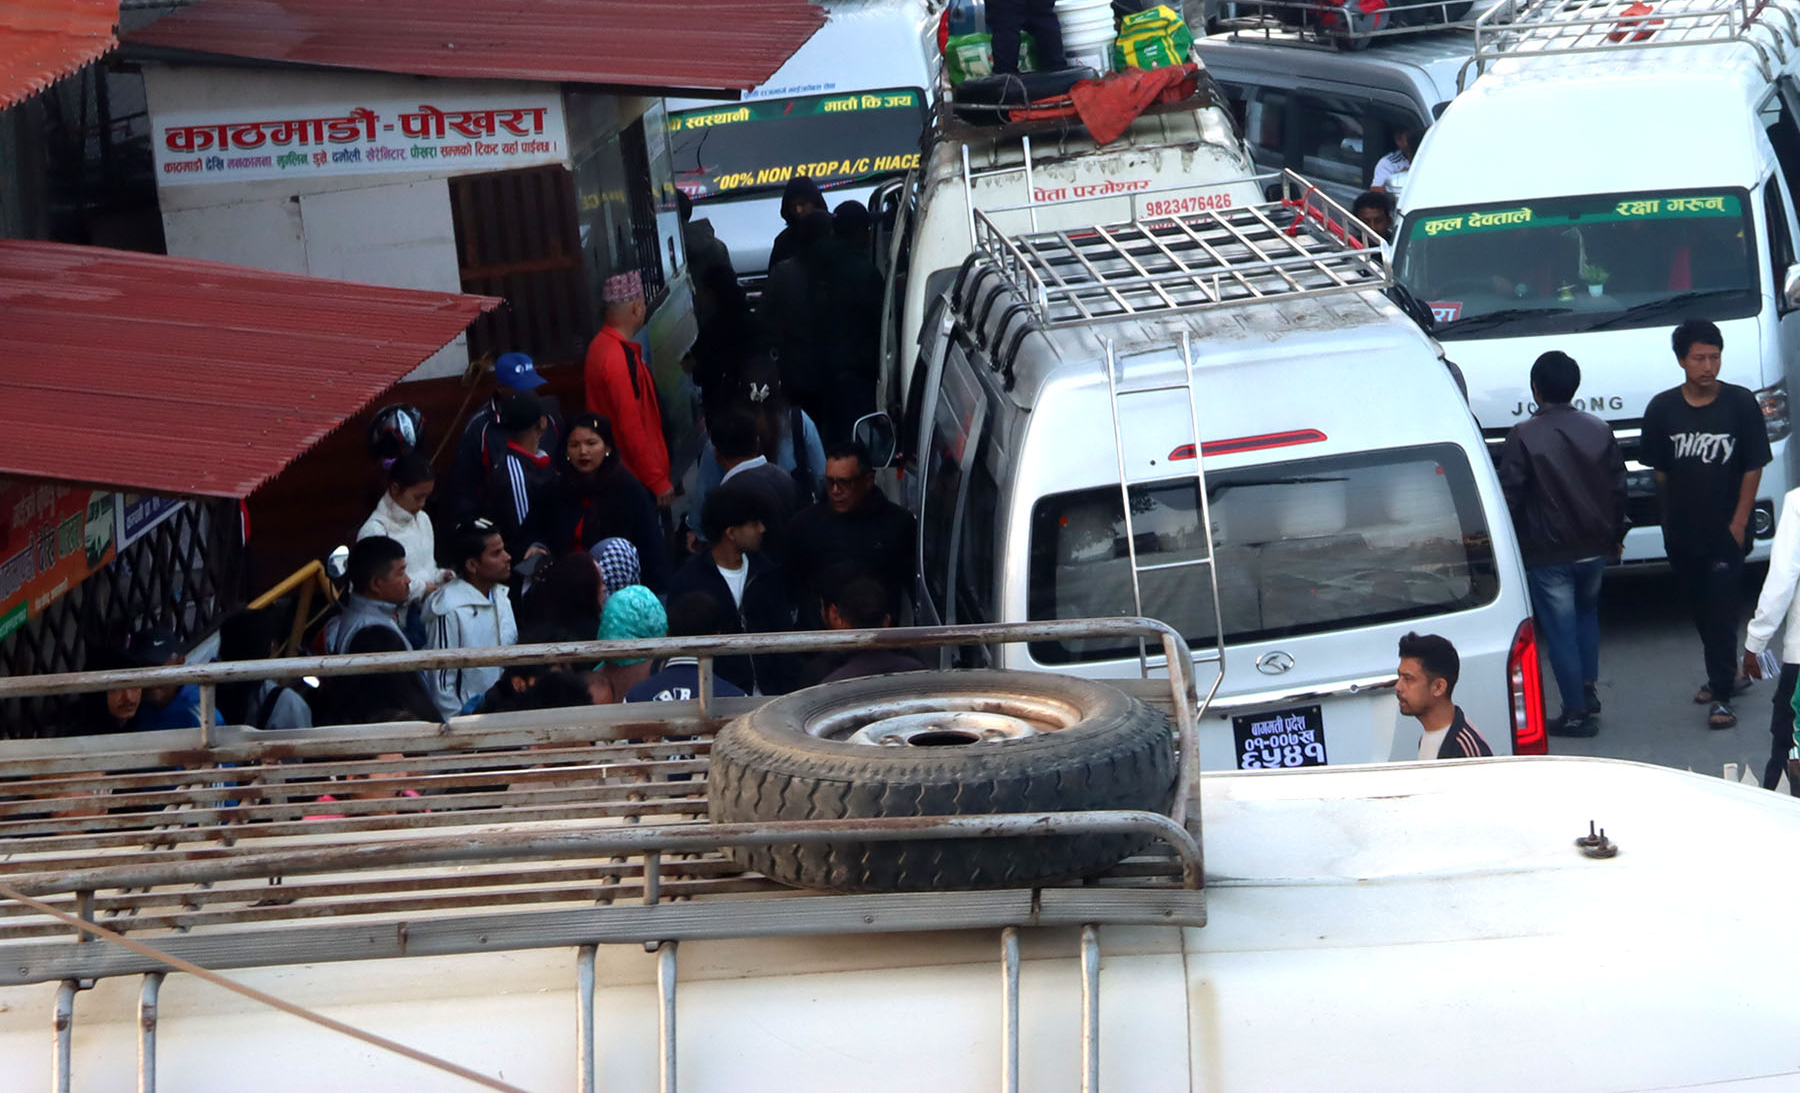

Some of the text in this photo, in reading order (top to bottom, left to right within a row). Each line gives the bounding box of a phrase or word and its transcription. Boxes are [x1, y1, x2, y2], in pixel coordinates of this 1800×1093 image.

[713, 173, 754, 190] 00%
[757, 166, 793, 185] NON
[796, 162, 840, 178] STOP
[840, 158, 869, 175] A/C
[873, 153, 921, 171] HIACE
[1146, 193, 1232, 217] 9823476426
[1616, 200, 1660, 216] रक्षा
[1424, 207, 1532, 236] कुल देवताले
[1511, 396, 1624, 417] JOONG
[1251, 715, 1283, 737] बागमती
